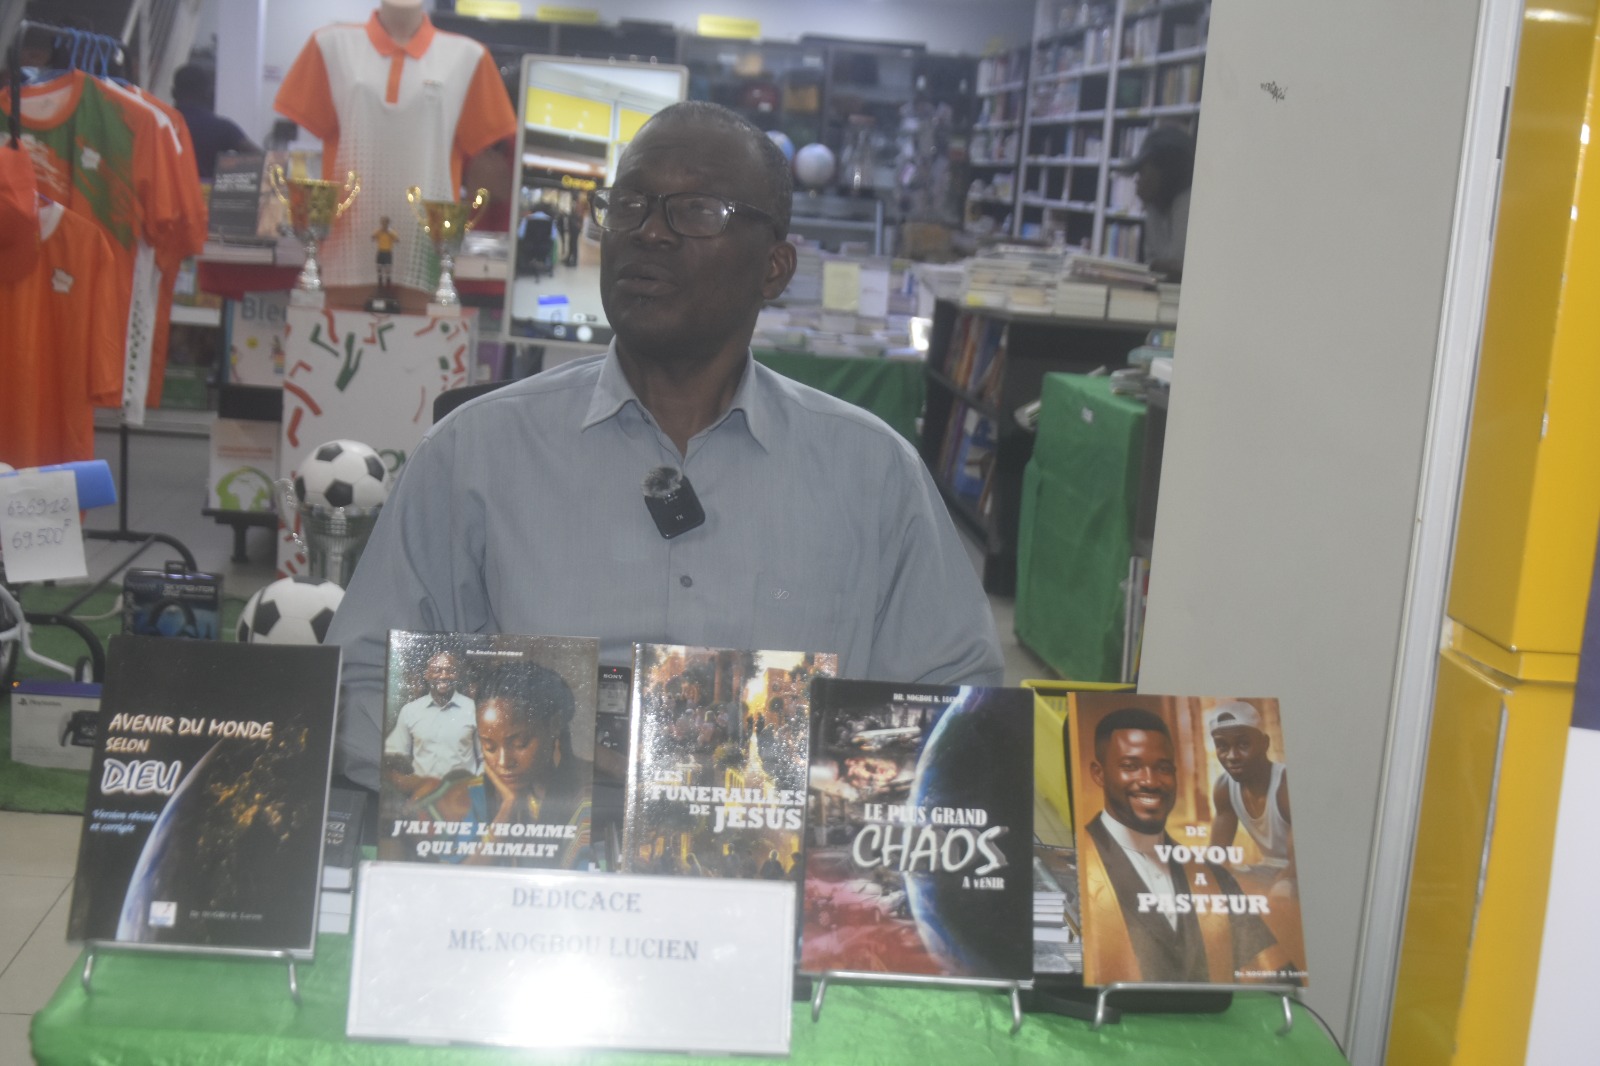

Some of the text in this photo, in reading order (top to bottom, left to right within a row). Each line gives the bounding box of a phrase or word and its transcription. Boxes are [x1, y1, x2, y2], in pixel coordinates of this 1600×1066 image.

[893, 692, 905, 701] DR.
[906, 693, 932, 702] NOGBOU
[108, 713, 175, 735] AVENIR
[178, 717, 206, 736] DU
[208, 719, 274, 739] MONDE
[105, 737, 150, 753] SELON
[101, 758, 182, 796] DIEU
[654, 770, 683, 782] LES
[650, 785, 806, 806] FUNERAILLES
[689, 804, 802, 833] DE JESUS
[864, 803, 987, 826] LE PLUS GRAND
[391, 820, 578, 839] J'AI TUE L'HOMME
[1185, 826, 1207, 837] DE
[416, 840, 558, 858] QUI M'AIMAIT
[852, 823, 1009, 875] CHAOS
[1154, 845, 1244, 864] VOYOU
[962, 876, 970, 889] A
[1194, 872, 1208, 886] A
[511, 887, 642, 914] DEDICACE
[1137, 893, 1271, 915] PASTEUR
[608, 937, 699, 961] LUCIEN
